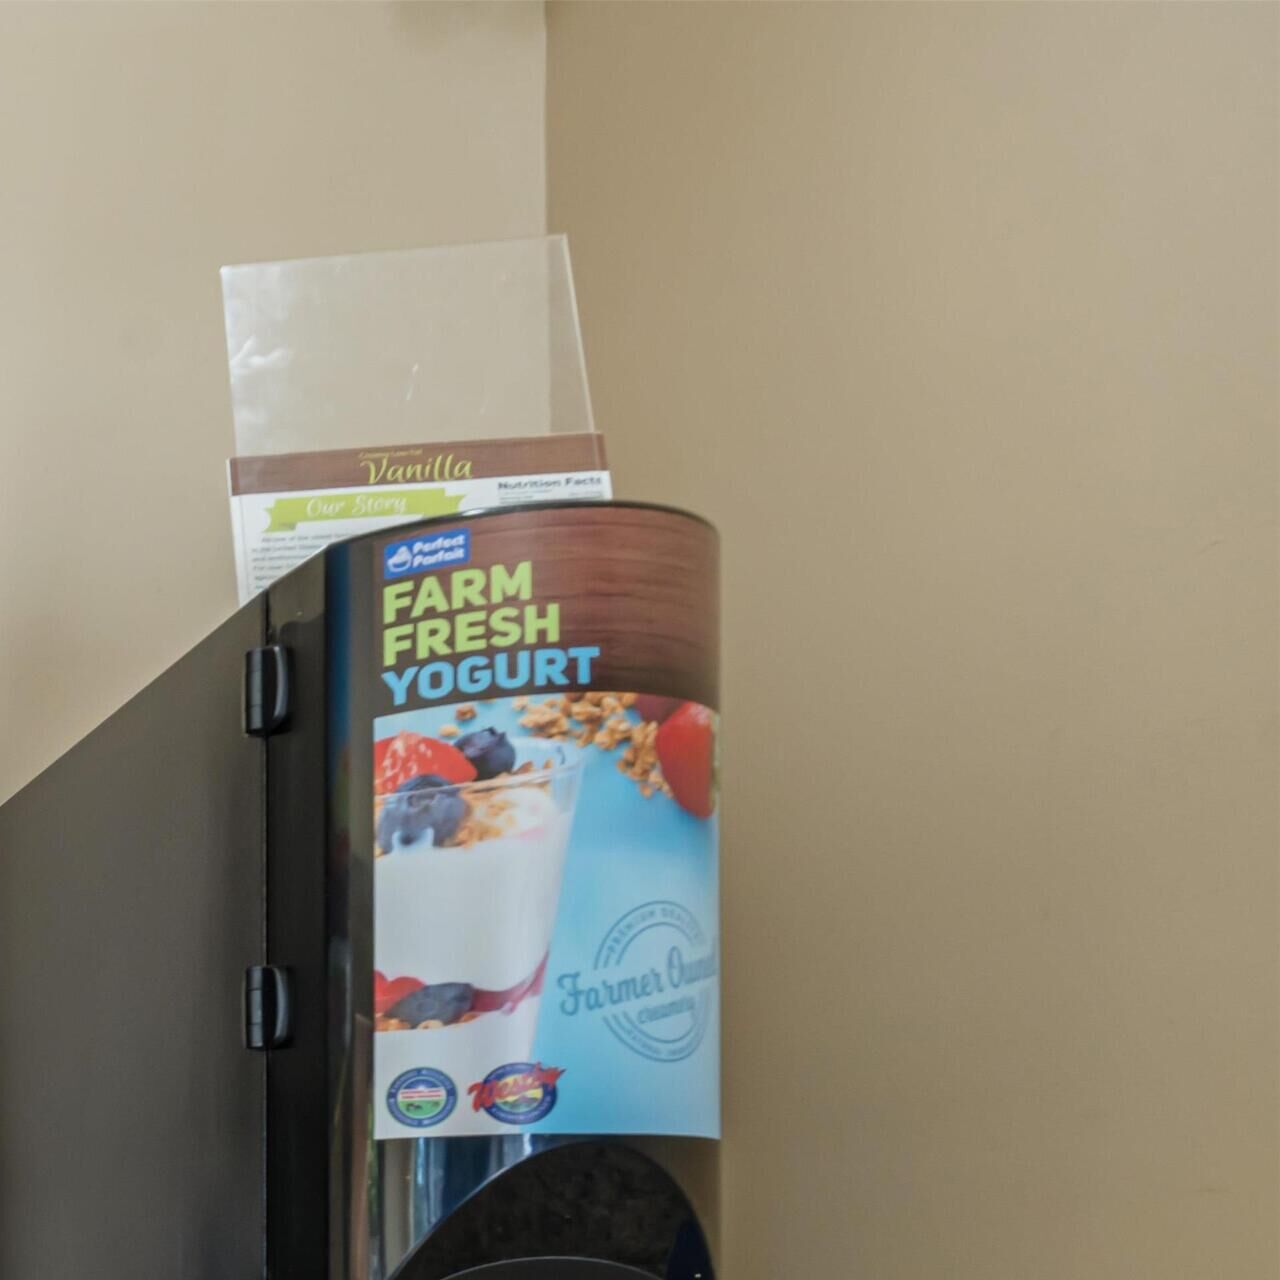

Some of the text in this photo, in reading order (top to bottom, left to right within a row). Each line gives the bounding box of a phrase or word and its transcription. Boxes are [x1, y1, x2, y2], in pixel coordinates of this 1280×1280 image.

[360, 453, 472, 485] Vanilla
[498, 477, 602, 490] Nutrition Facts
[307, 495, 407, 517] Our Story
[412, 534, 466, 554] Perfect
[412, 548, 465, 568] Parfait
[383, 560, 533, 625] FARM
[383, 602, 560, 667] FRESH
[381, 646, 600, 706] YOGURT
[557, 968, 663, 1016] Farmer
